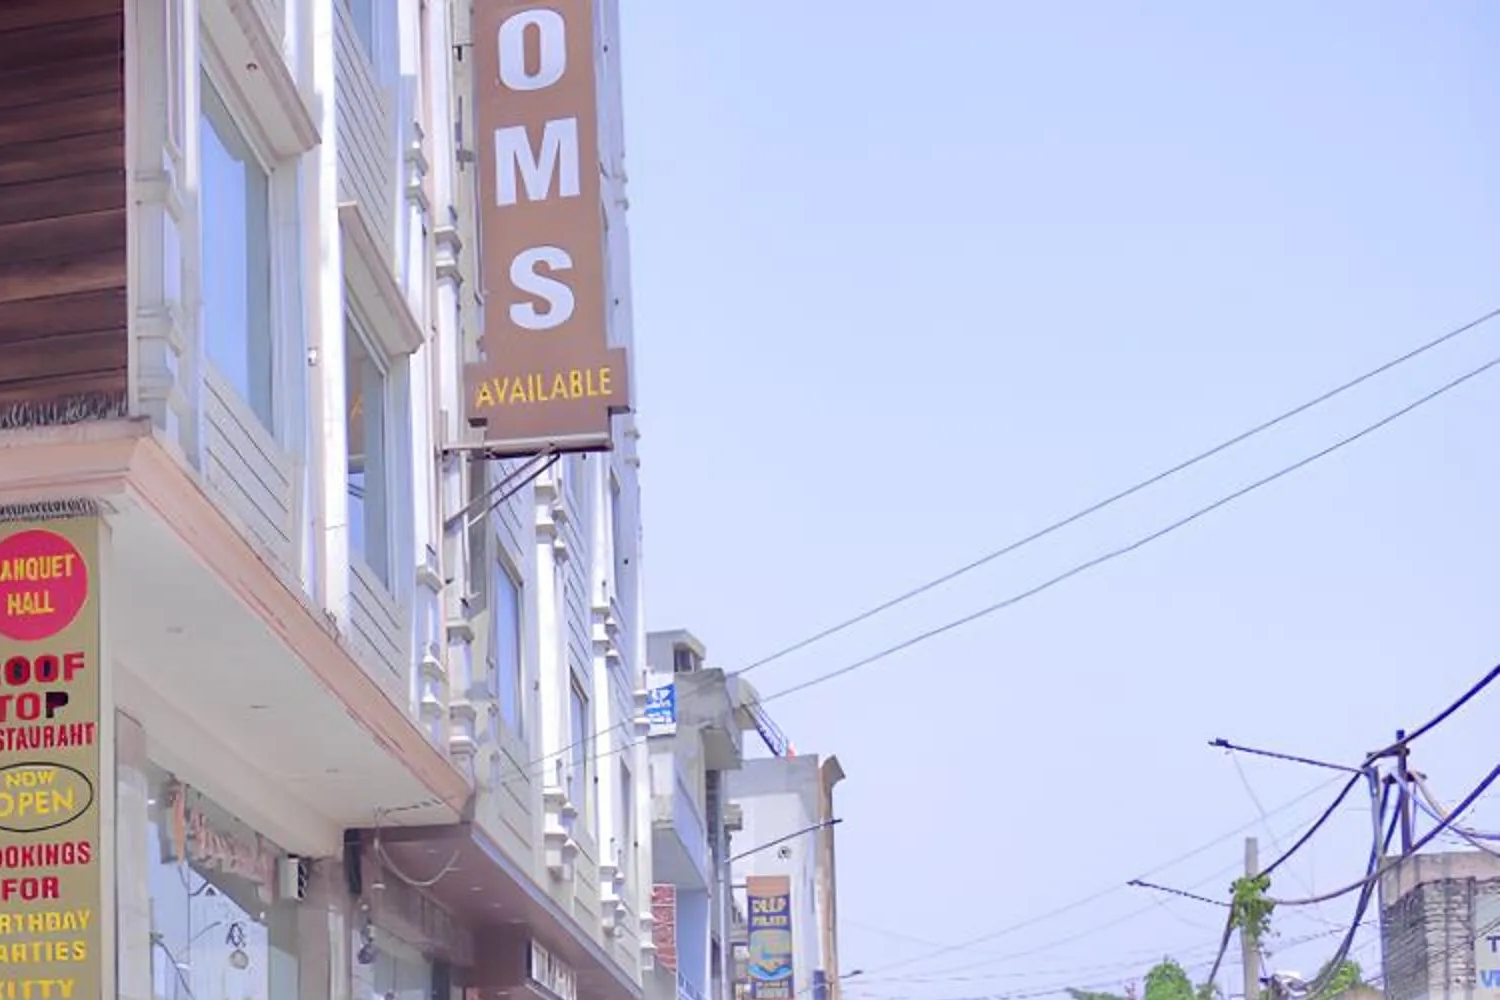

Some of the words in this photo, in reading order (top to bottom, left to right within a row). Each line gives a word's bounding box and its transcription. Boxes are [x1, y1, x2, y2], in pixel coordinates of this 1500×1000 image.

[475, 367, 614, 409] AVAILABLE
[7, 589, 55, 617] HALL
[5, 769, 57, 788] NOW
[1, 876, 59, 902] FOR
